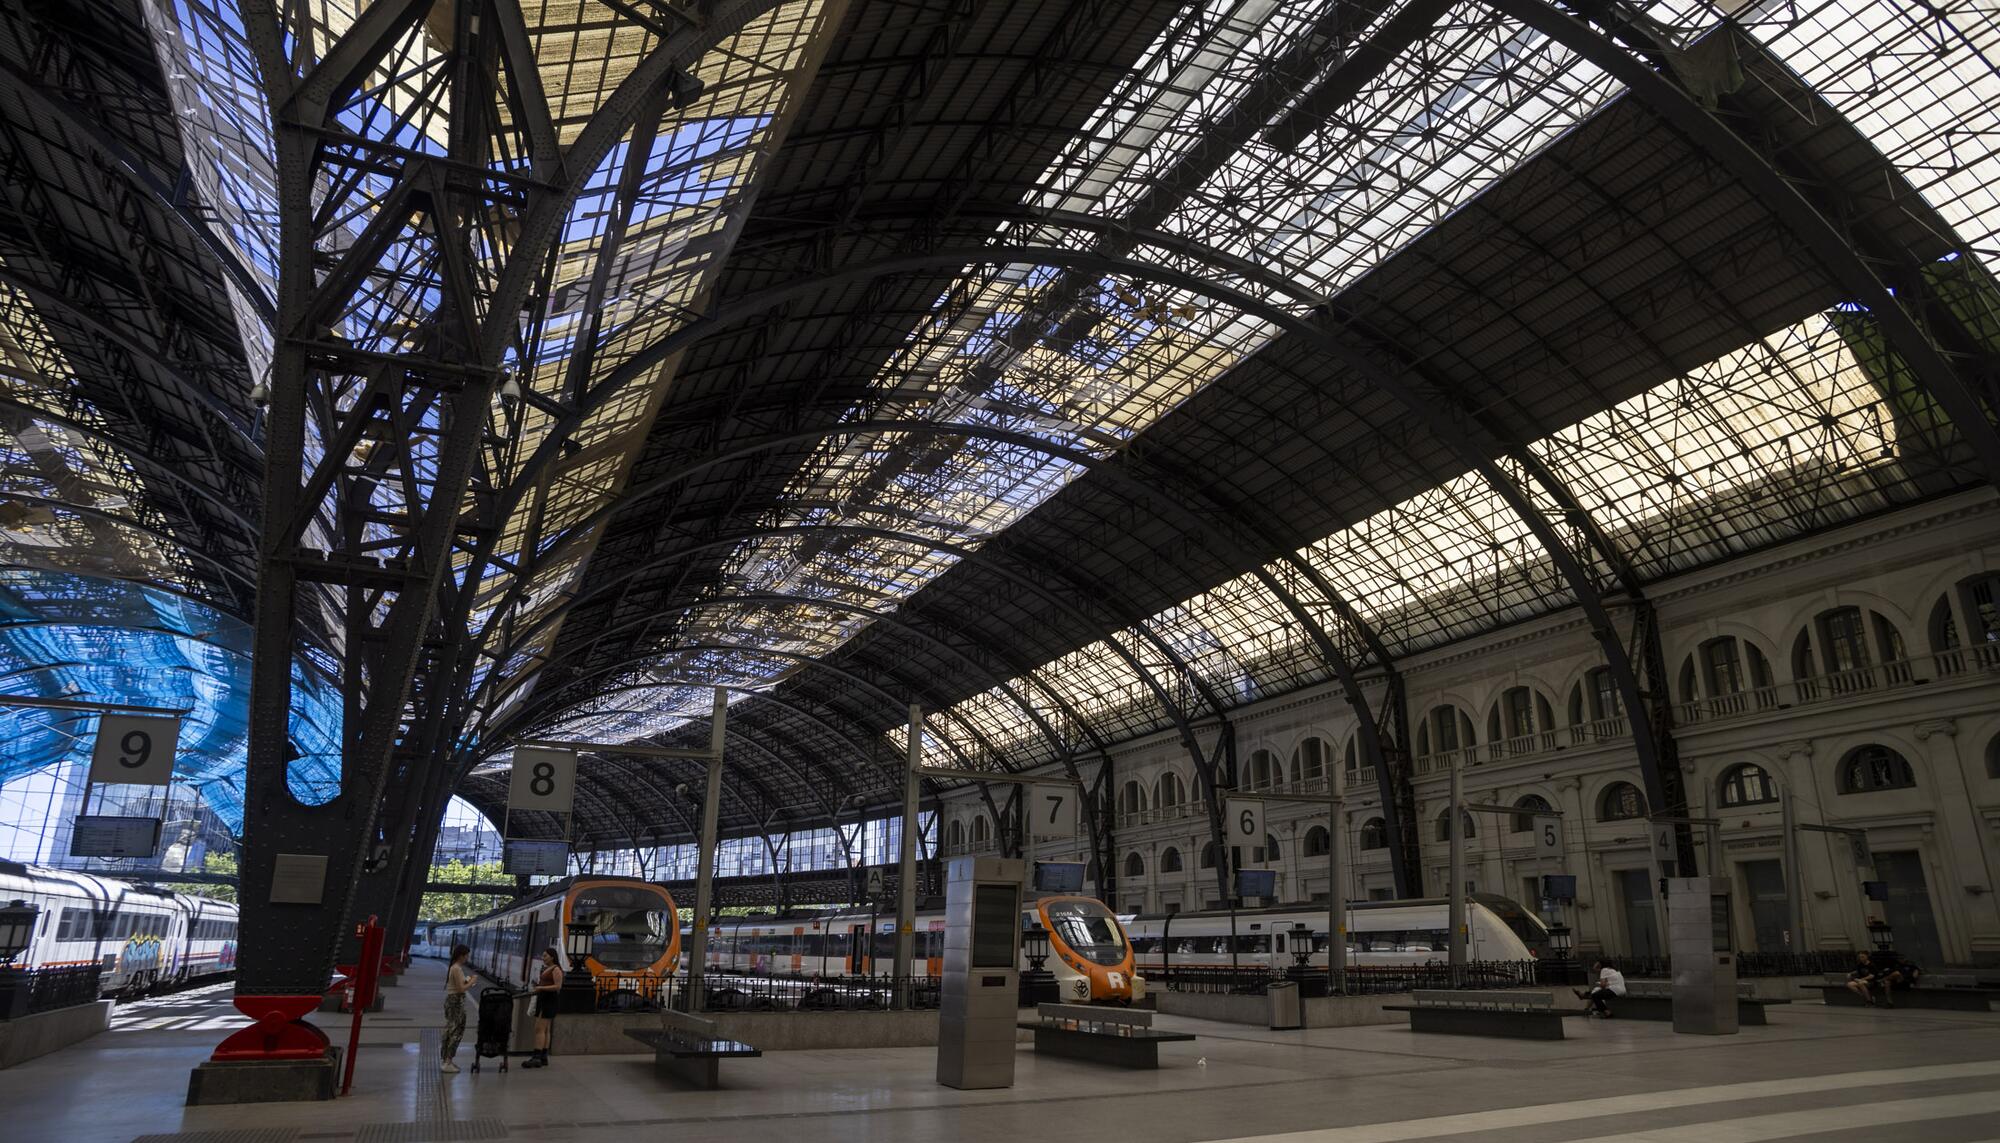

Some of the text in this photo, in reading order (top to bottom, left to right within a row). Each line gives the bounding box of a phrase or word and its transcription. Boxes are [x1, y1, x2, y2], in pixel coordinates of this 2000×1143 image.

[119, 730, 152, 768] 9
[530, 762, 555, 796] 8
[1046, 796, 1063, 824] 7
[1240, 809, 1255, 835] 6
[1544, 825, 1556, 846] 5
[1658, 831, 1670, 852] 4
[1855, 841, 1865, 859] 3
[870, 871, 881, 884] A
[1107, 972, 1125, 989] R
